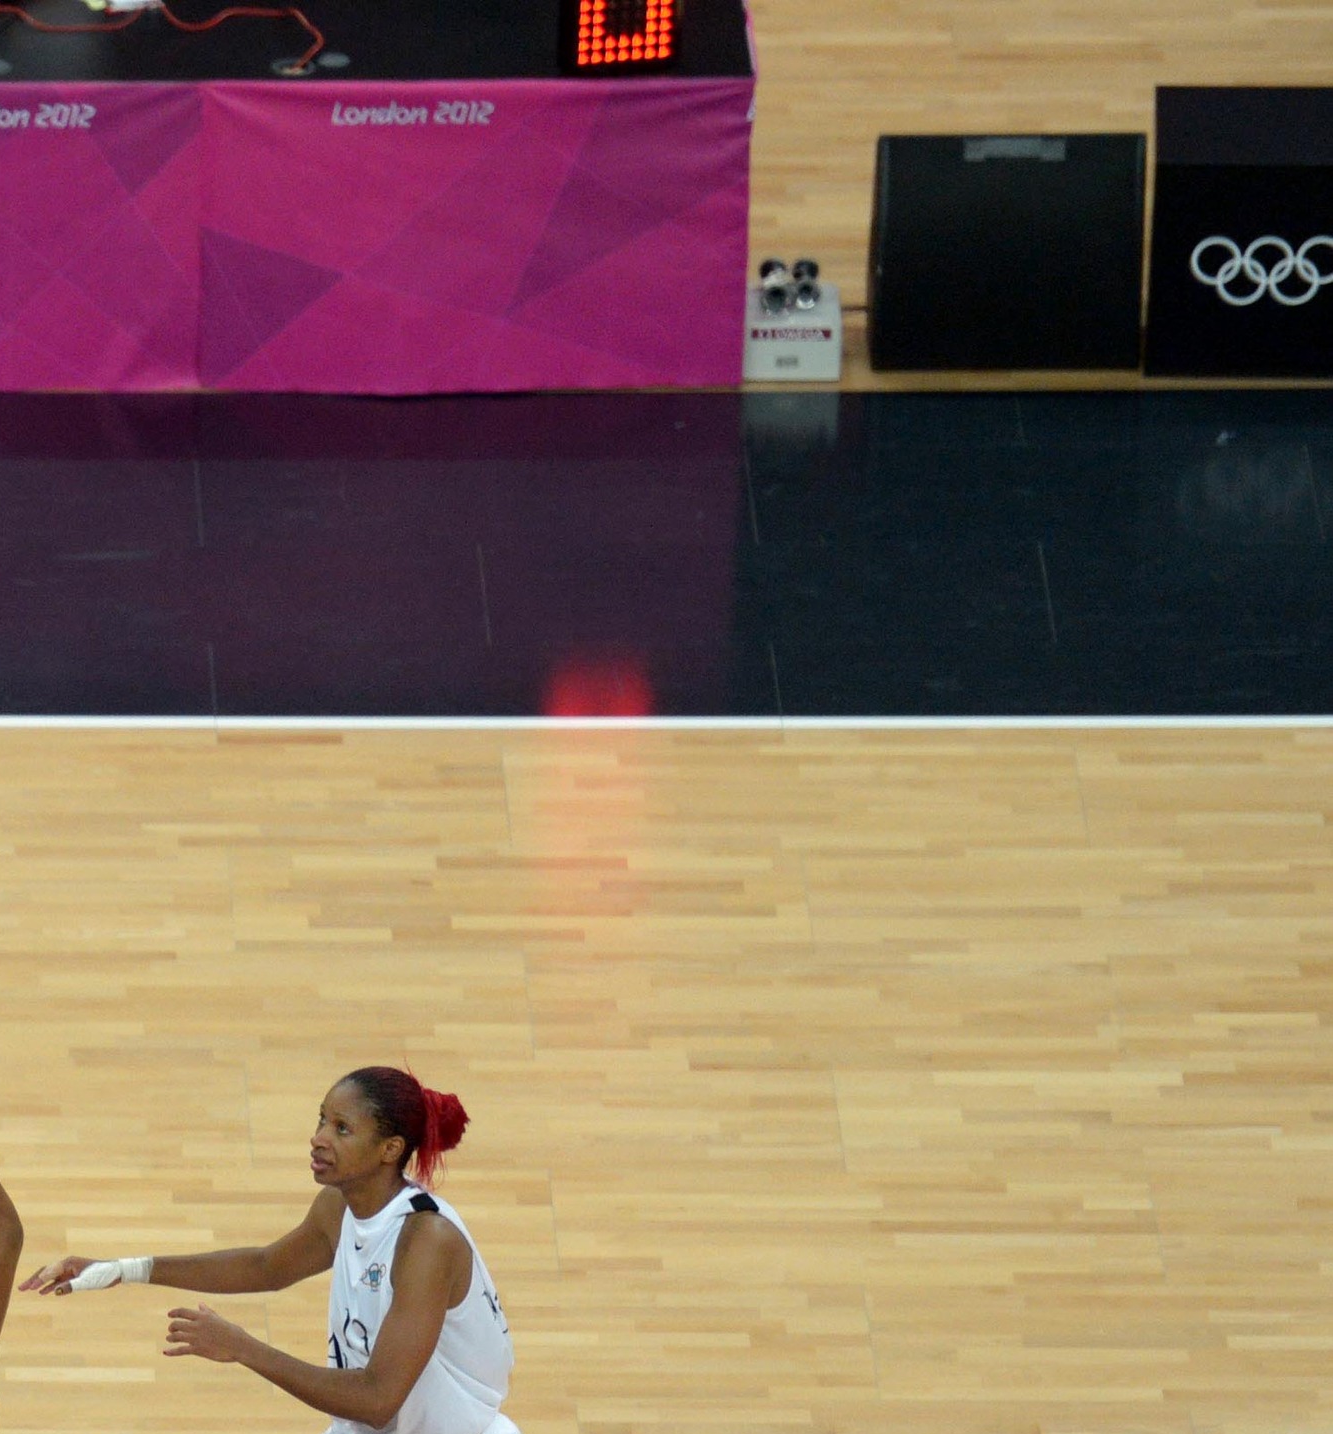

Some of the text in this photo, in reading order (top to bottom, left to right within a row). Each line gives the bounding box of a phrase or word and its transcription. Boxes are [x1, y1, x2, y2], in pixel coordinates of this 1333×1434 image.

[34, 103, 96, 128] 2012
[331, 102, 495, 125] London 2012
